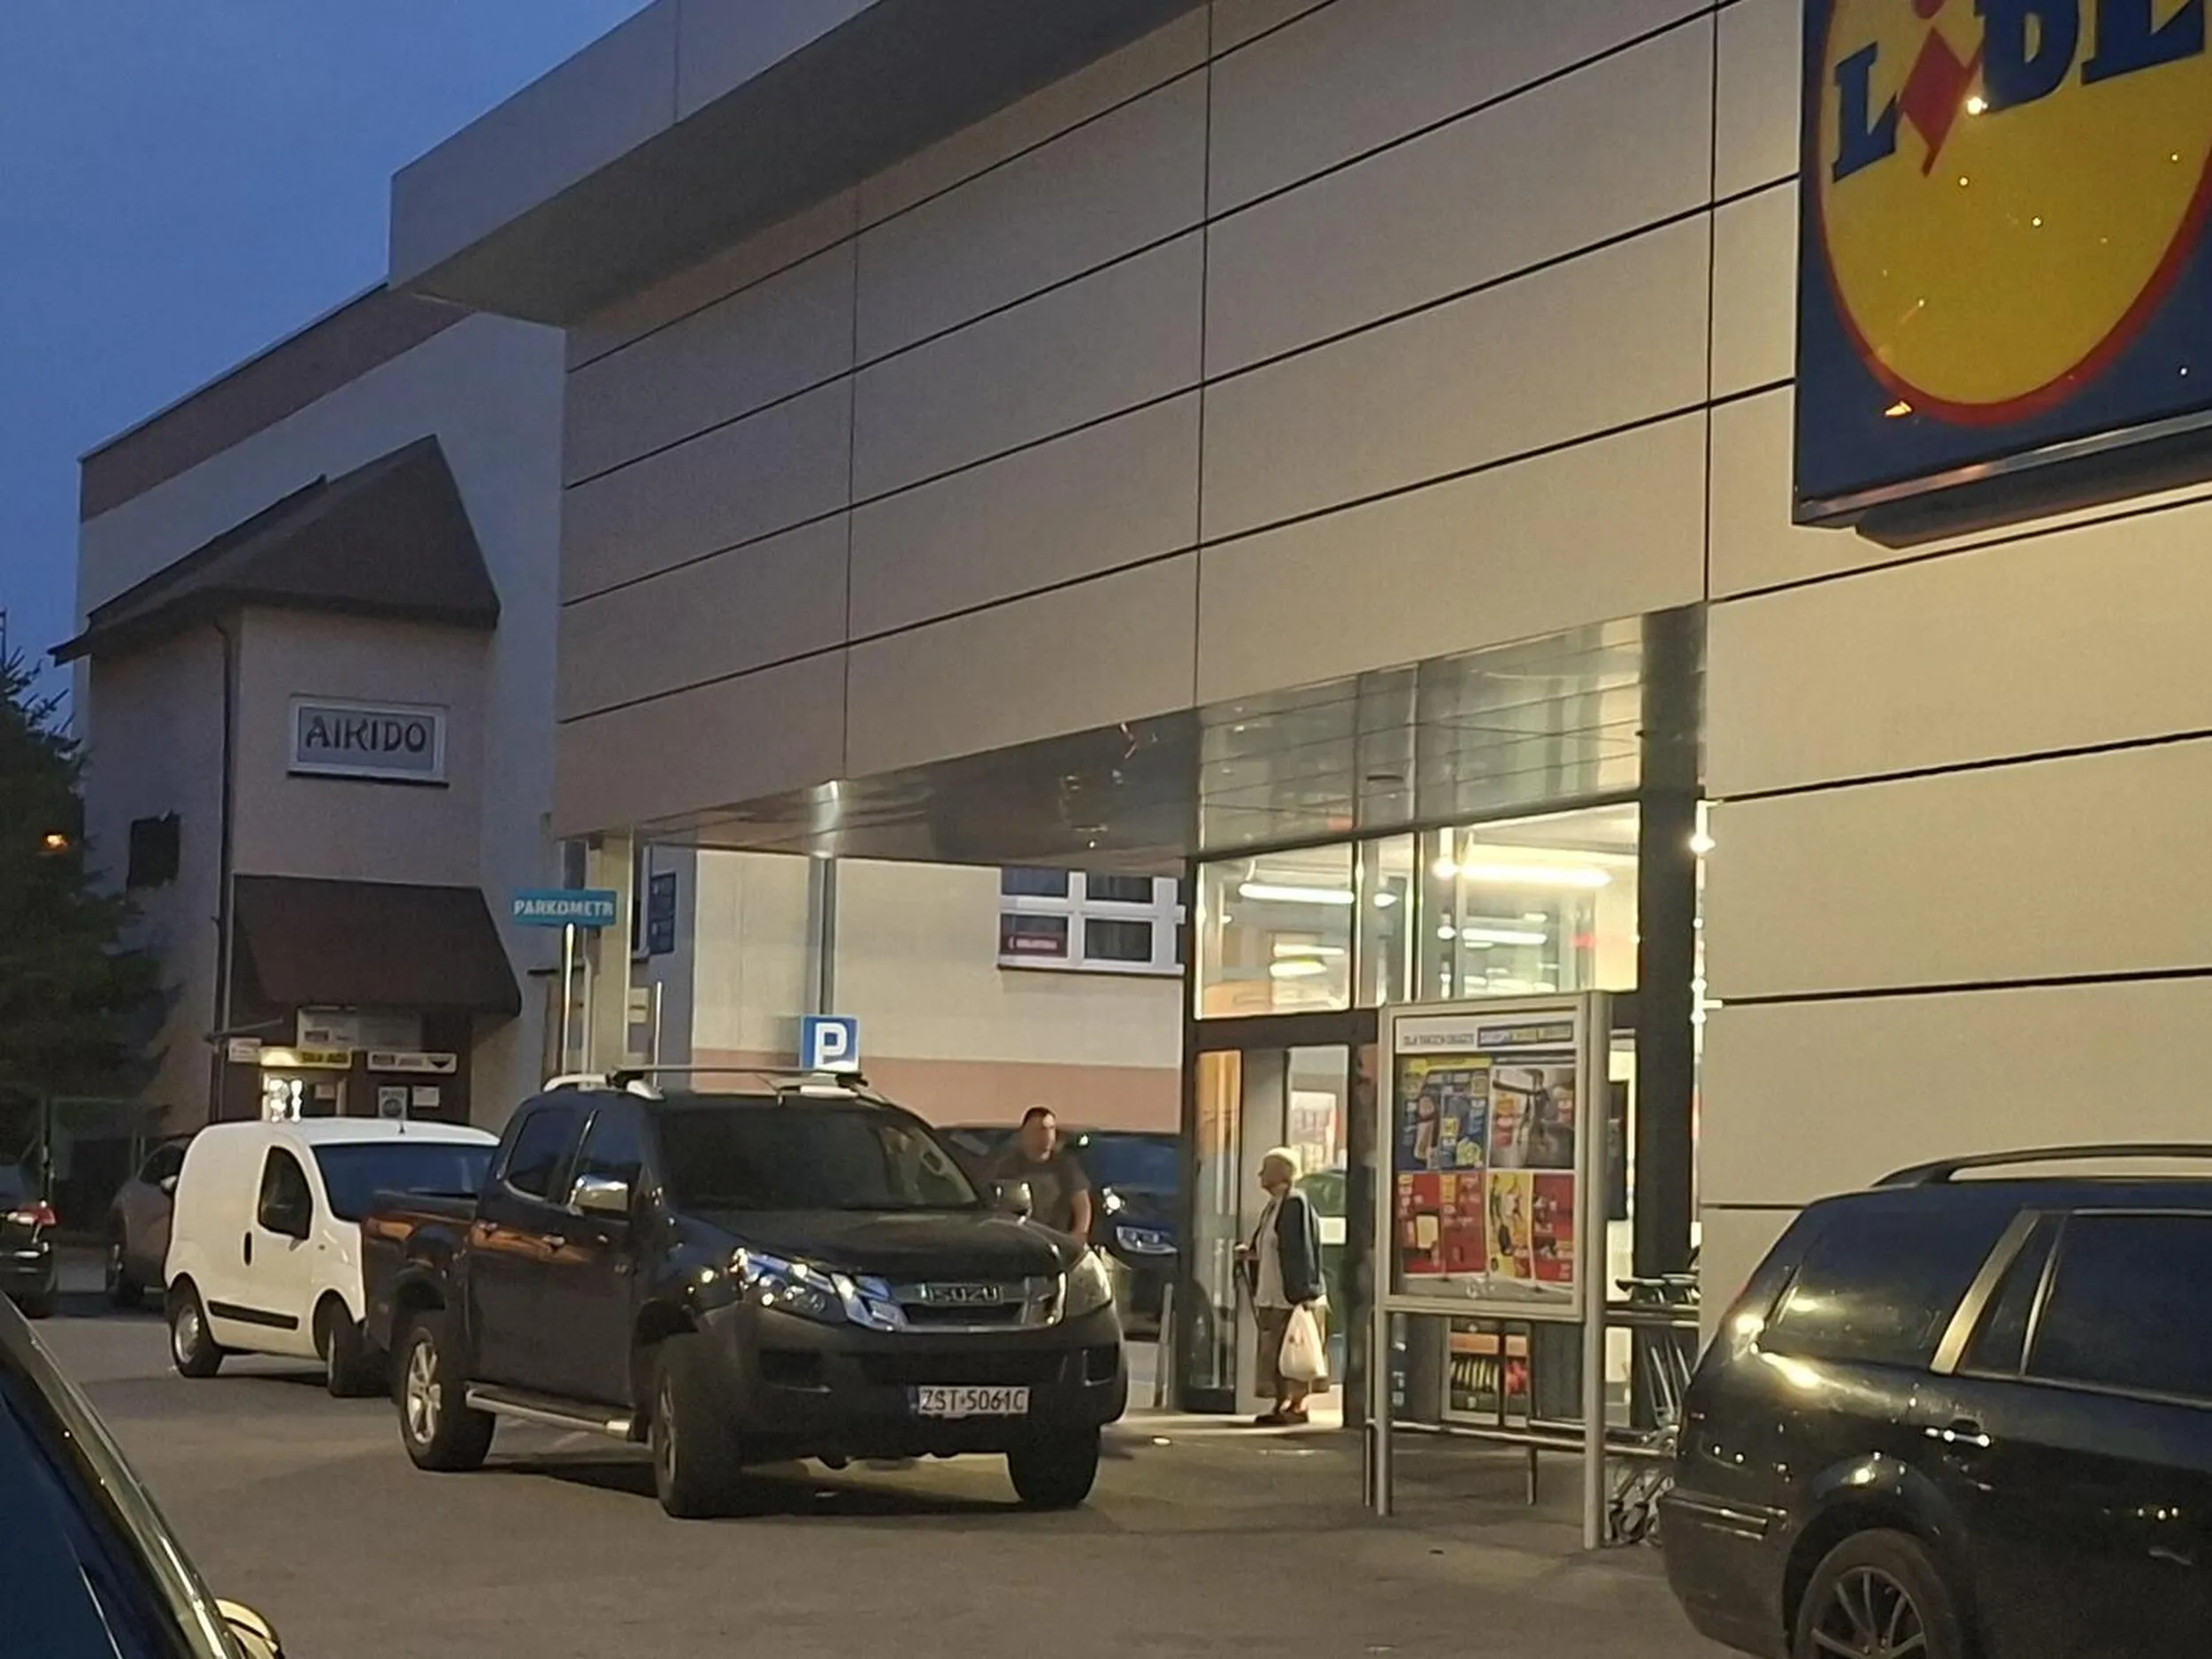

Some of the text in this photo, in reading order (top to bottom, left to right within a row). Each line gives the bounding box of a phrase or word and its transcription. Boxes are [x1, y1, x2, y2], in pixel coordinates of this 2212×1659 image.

[305, 715, 427, 753] AIKIDO
[512, 898, 615, 917] PARKOMETR
[813, 1021, 848, 1070] P
[929, 1285, 999, 1302] ISUZU
[921, 1388, 1025, 1411] ZST 5061C
